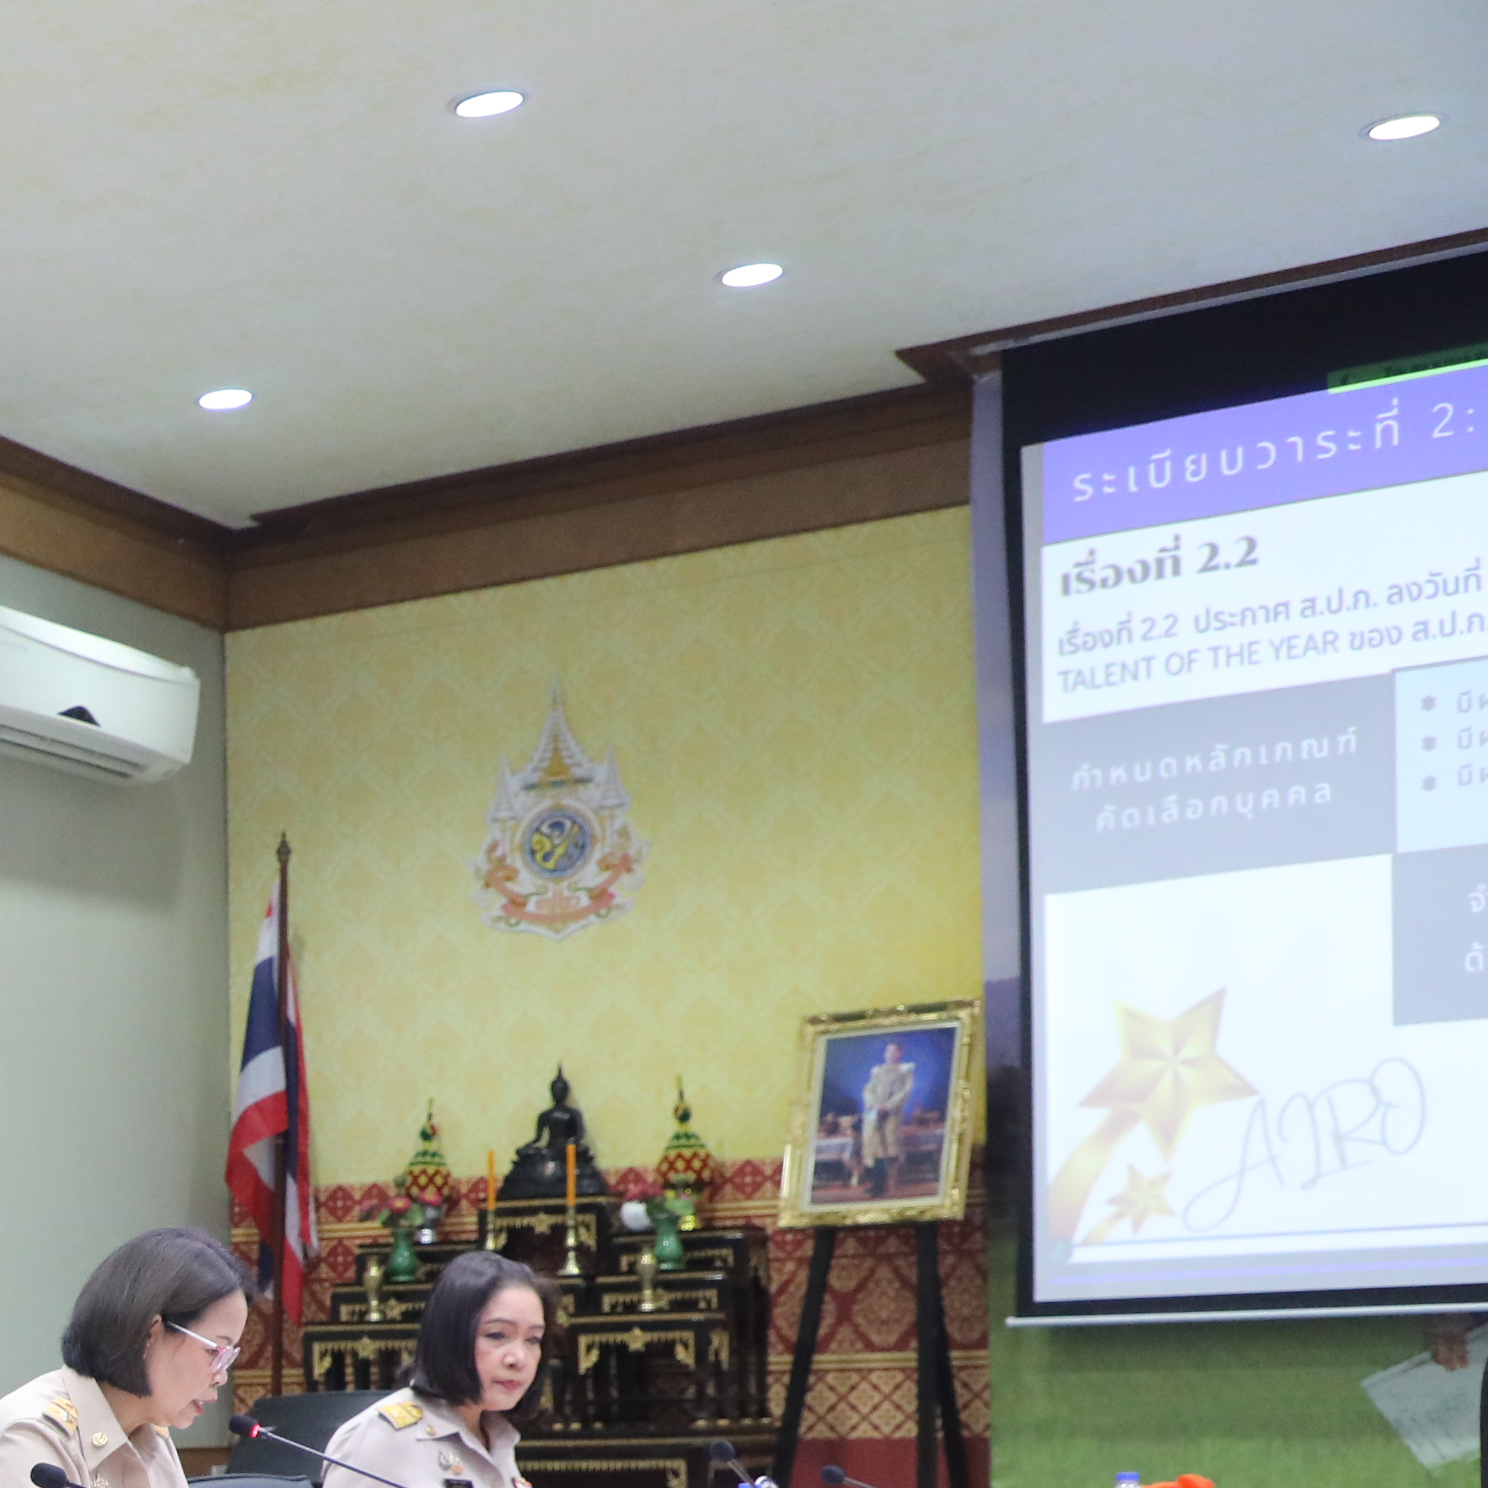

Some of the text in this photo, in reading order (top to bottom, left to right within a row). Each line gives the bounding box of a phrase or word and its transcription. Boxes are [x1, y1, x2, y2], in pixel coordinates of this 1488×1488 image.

[1073, 398, 1475, 501] ระเบียบวาระที่ 2:
[1060, 533, 1259, 596] เรื่องที่ 2.2
[1058, 556, 1482, 657] เรื่องที่ 2.2 ประกาศ ส.ป.ก. ลงวันที่
[1056, 656, 1157, 695] TALENT
[1164, 649, 1200, 678] OF
[1208, 640, 1262, 670] THE
[1268, 630, 1340, 663] YEAR
[1349, 623, 1402, 652] ของ
[1070, 726, 1358, 793] กำหนดหลักเกณฑ์
[1095, 782, 1331, 833] คัดเลือกบุคคล
